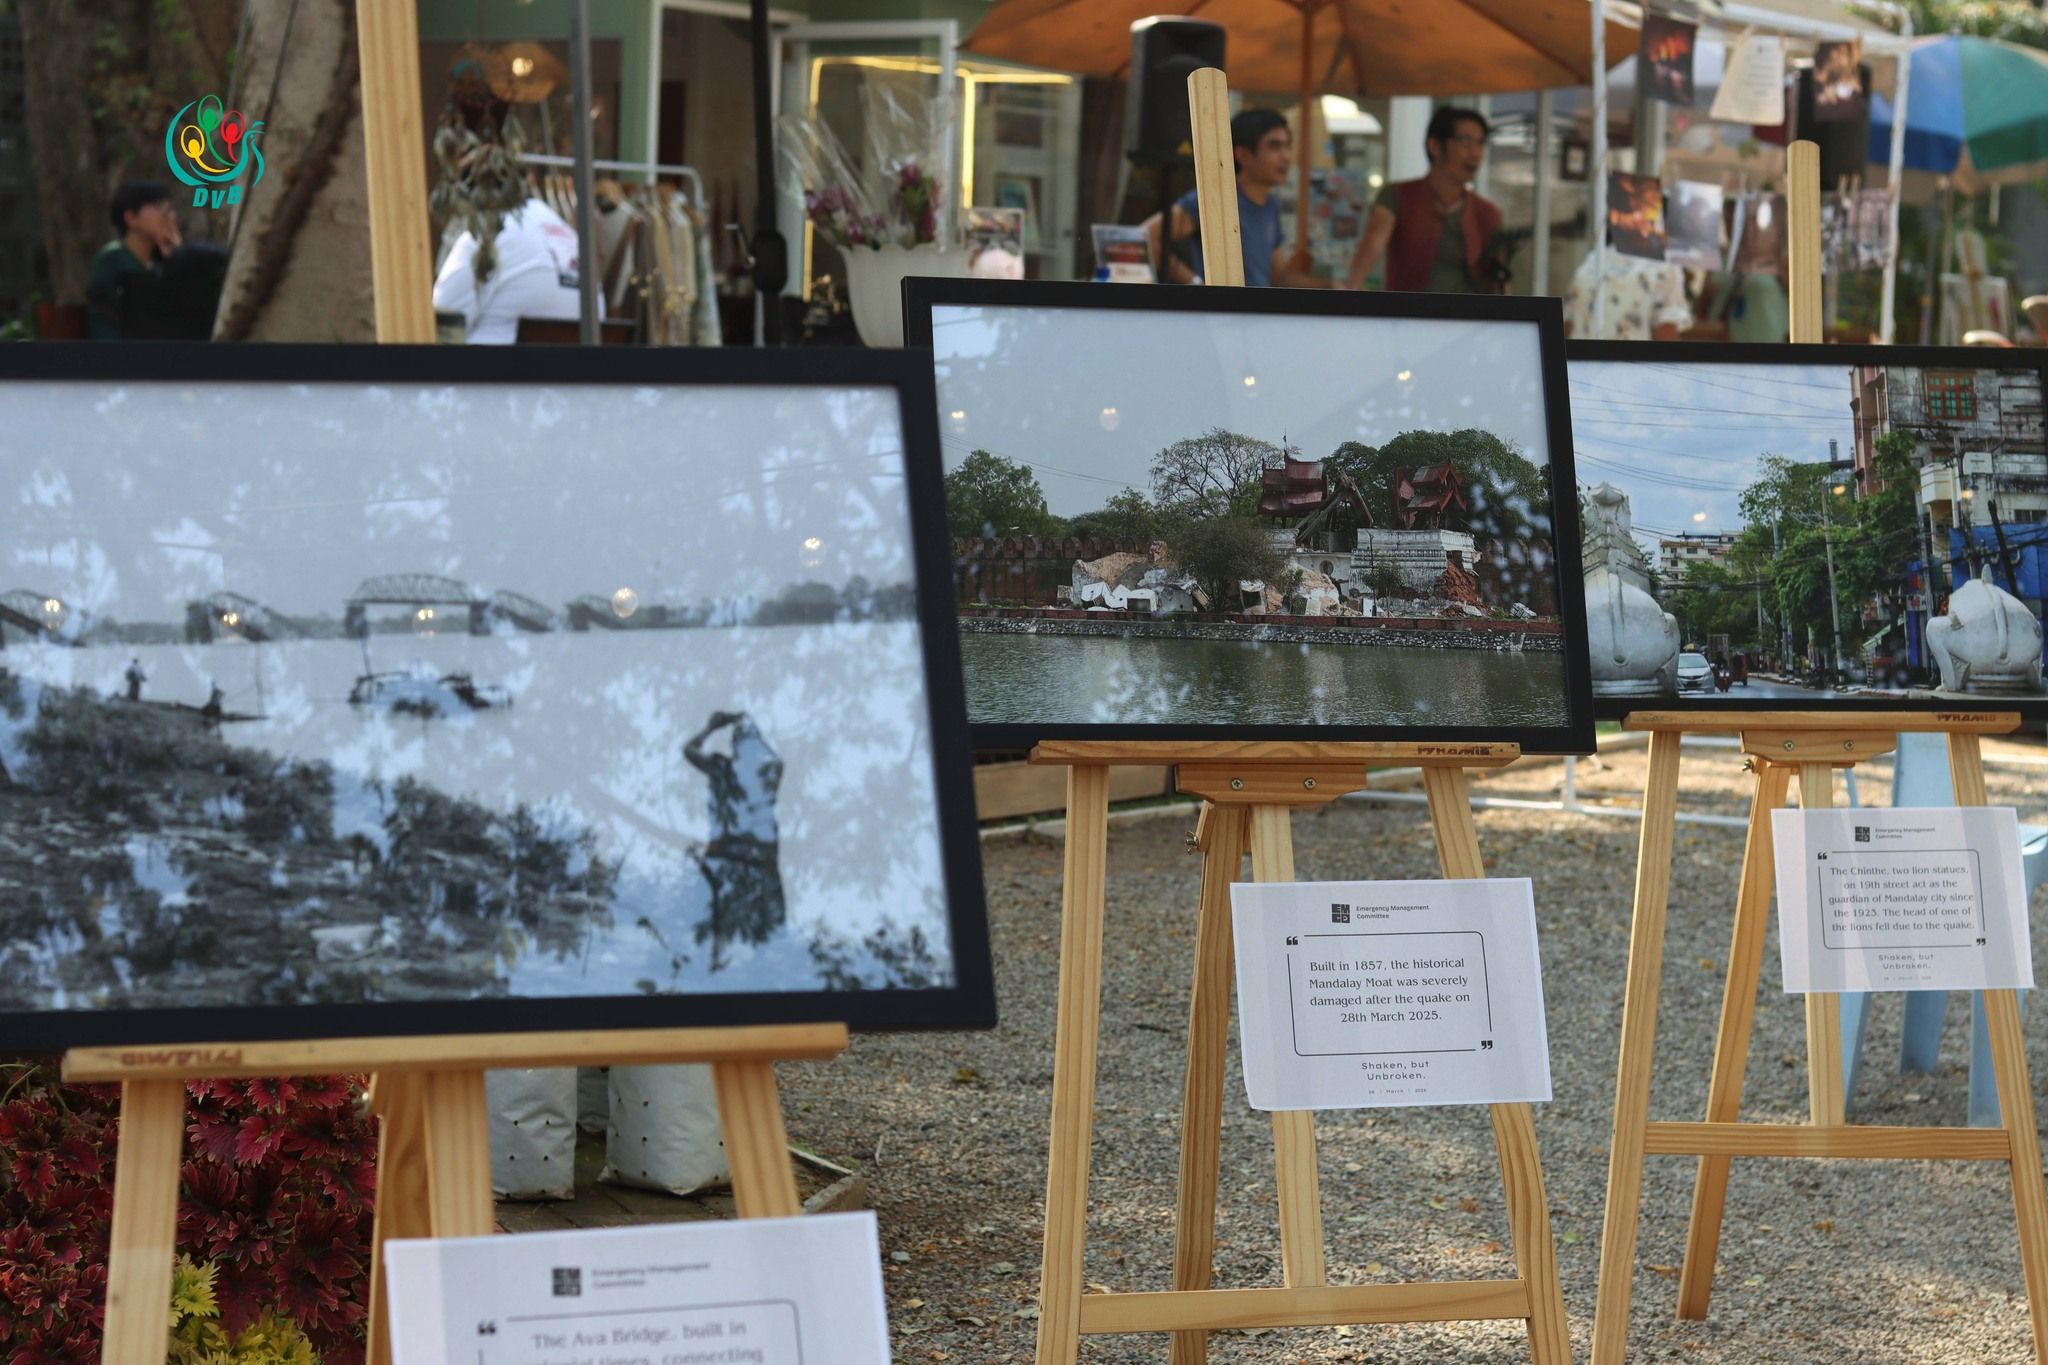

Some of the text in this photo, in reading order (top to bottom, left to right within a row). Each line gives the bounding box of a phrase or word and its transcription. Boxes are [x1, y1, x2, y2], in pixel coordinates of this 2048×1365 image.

[1830, 867, 1847, 875] The
[1850, 867, 1890, 876] Chinthe,
[1912, 866, 1929, 874] lion
[1860, 881, 1880, 889] 19th
[1883, 881, 1909, 889] street
[1912, 880, 1926, 888] act
[1943, 880, 1958, 888] the
[1828, 893, 1974, 905] guardian of Mandalay city since
[1834, 909, 1849, 918] the
[1854, 909, 1879, 917] 1923.
[1883, 908, 1900, 917] The
[1903, 908, 1926, 916] head
[1928, 907, 1938, 915] of
[1961, 906, 1971, 915] of
[1832, 921, 1975, 931] the lions fell due to the quake.
[1879, 953, 1915, 961] Shaken,
[1310, 957, 1464, 972] Built in 1857, the historical
[1309, 975, 1468, 990] Mandalay Moat was severely
[1310, 993, 1470, 1008] damaged after the quake on
[1341, 1010, 1442, 1023] 28th March 2025.
[1361, 1060, 1429, 1070] Shaken, but
[1367, 1072, 1426, 1080] Unbroken.
[533, 1333, 565, 1349] The
[572, 1331, 607, 1346] Ava
[683, 1323, 723, 1339] built
[730, 1321, 747, 1336] in
